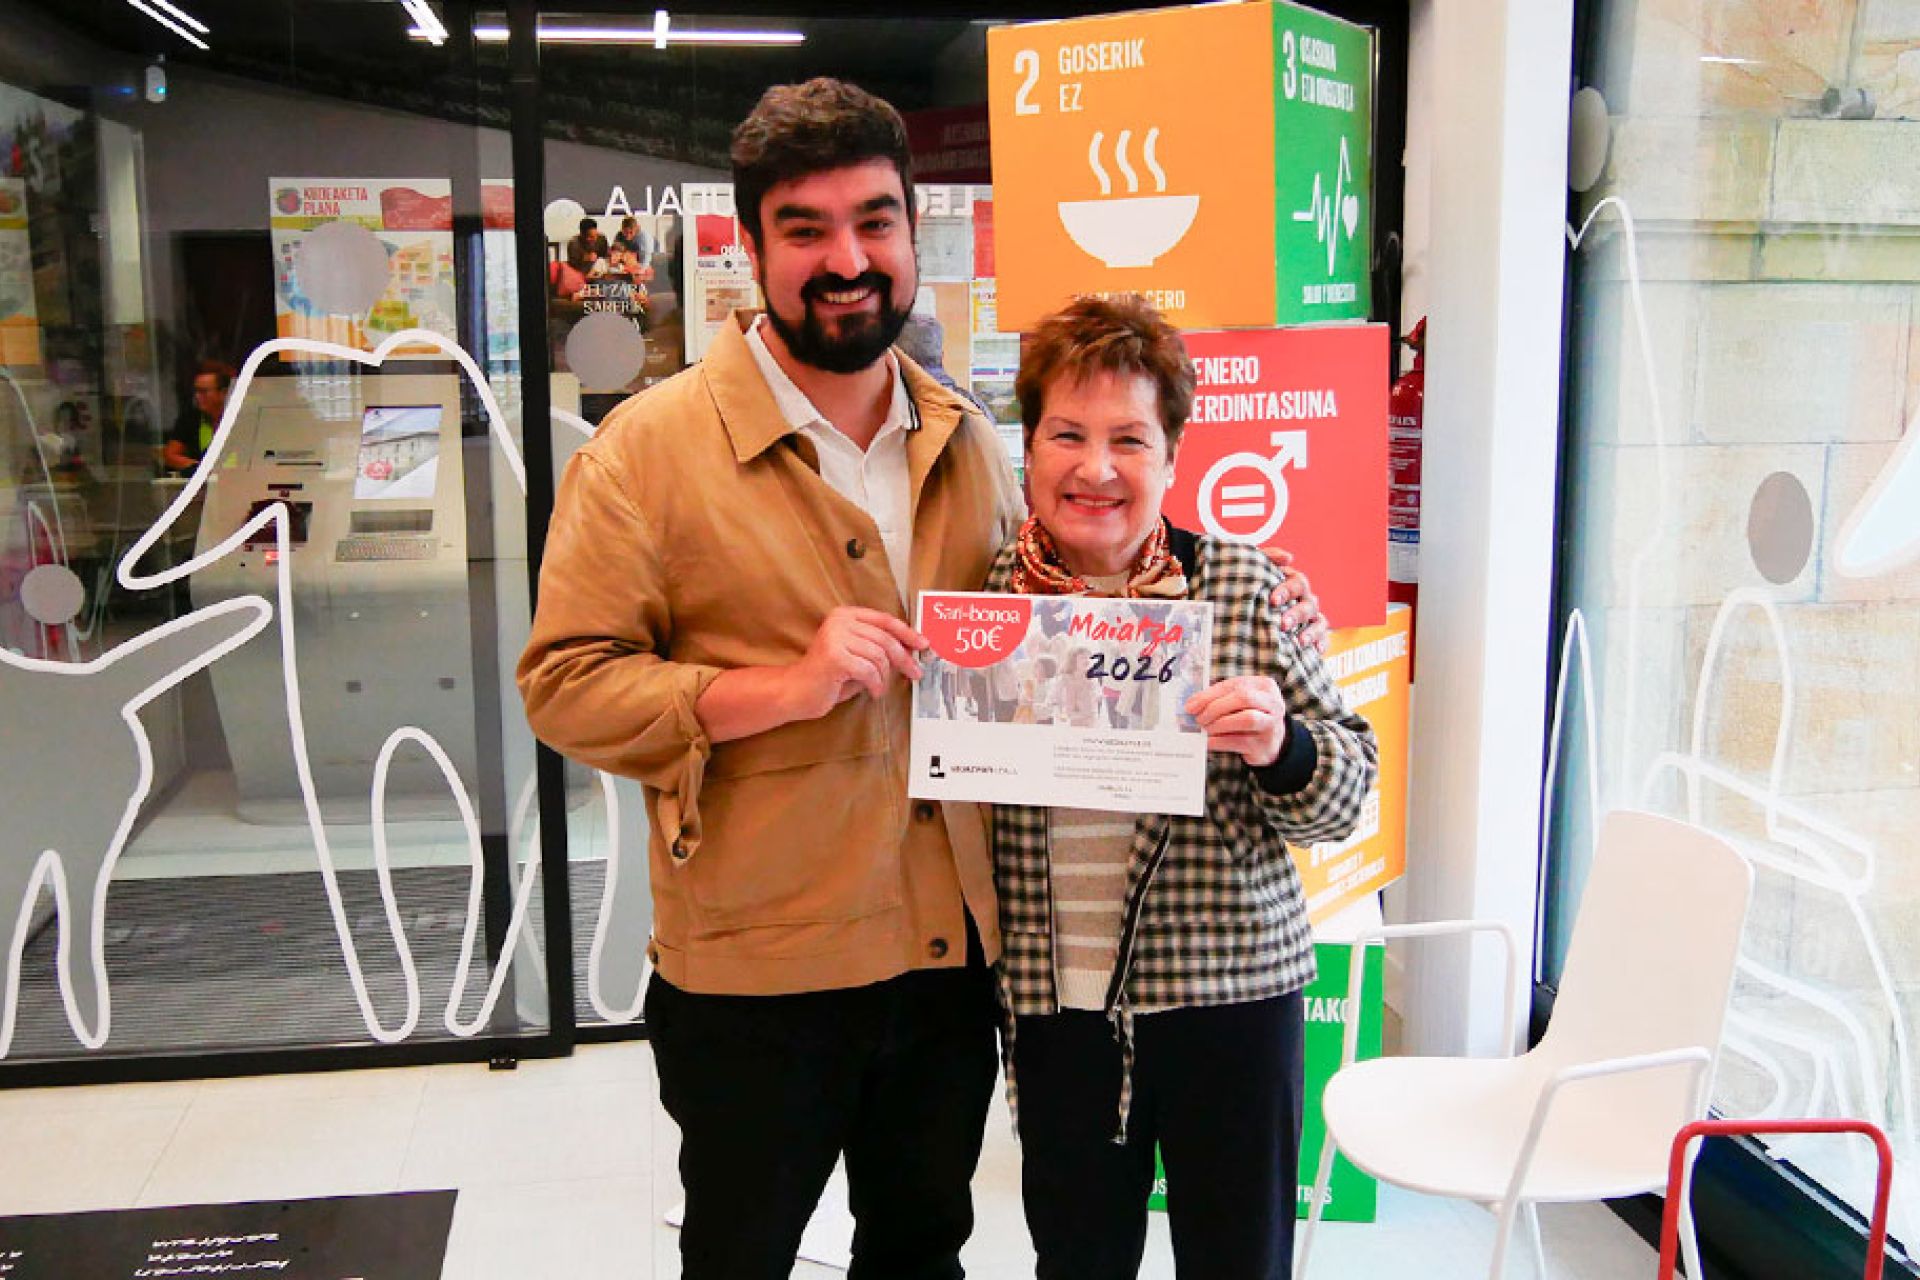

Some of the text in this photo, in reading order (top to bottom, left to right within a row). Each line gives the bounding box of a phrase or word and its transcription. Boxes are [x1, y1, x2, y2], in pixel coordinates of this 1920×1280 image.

[1058, 38, 1145, 75] GOSERIK
[1282, 30, 1297, 100] 3
[1014, 49, 1041, 116] 2
[1059, 83, 1084, 113] EZ
[303, 201, 341, 216] PLANA
[1192, 356, 1260, 386] ENERO
[1184, 389, 1338, 424] ERDINTASUNA
[954, 625, 1004, 654] 50€
[1086, 652, 1177, 684] 2026
